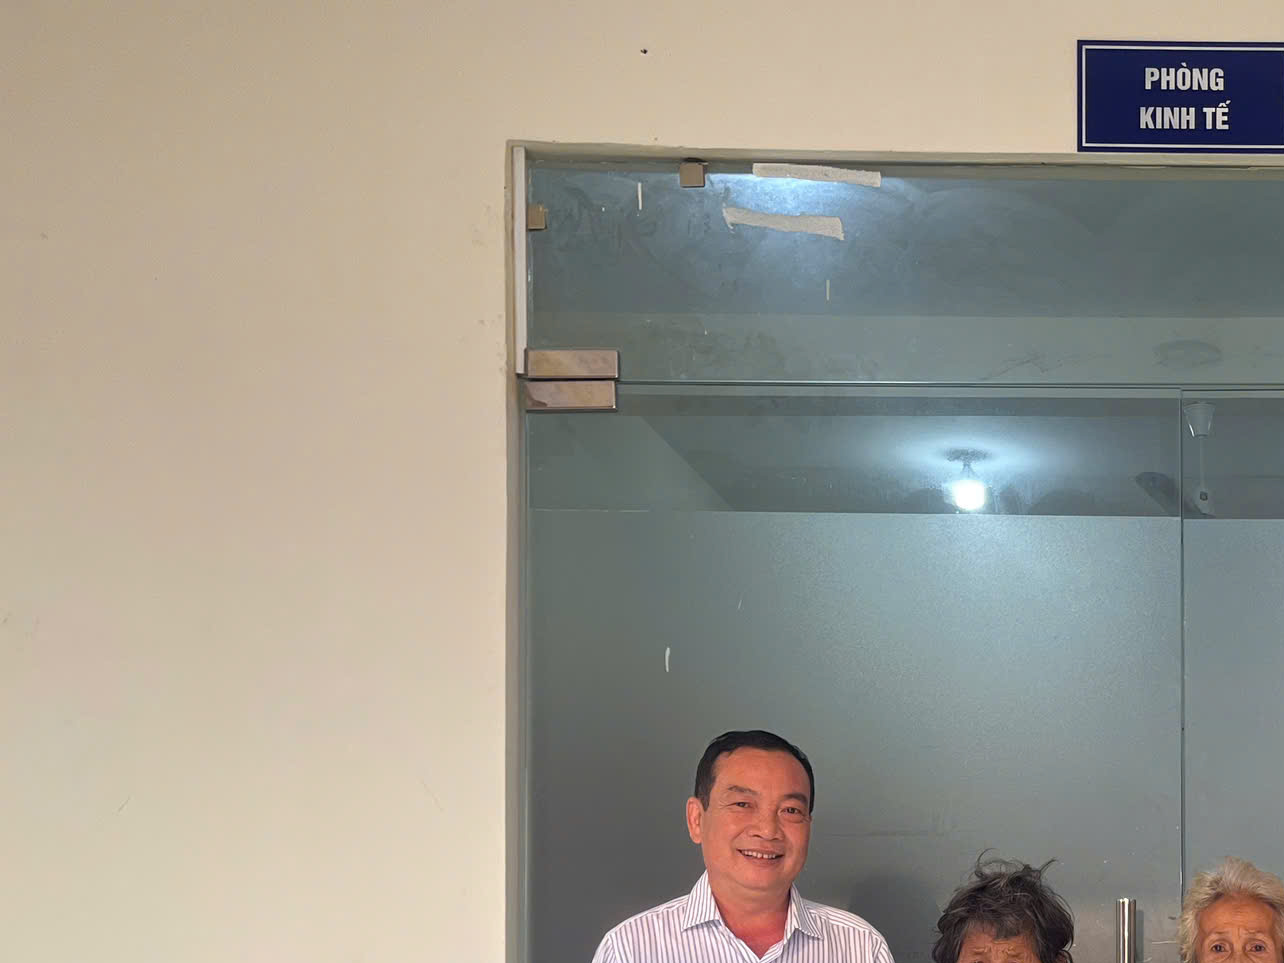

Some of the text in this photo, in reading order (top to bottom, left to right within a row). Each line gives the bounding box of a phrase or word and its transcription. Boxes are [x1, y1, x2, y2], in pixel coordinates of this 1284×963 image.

[1145, 62, 1225, 91] PHÒNG
[1139, 100, 1231, 130] KINH TẾ
